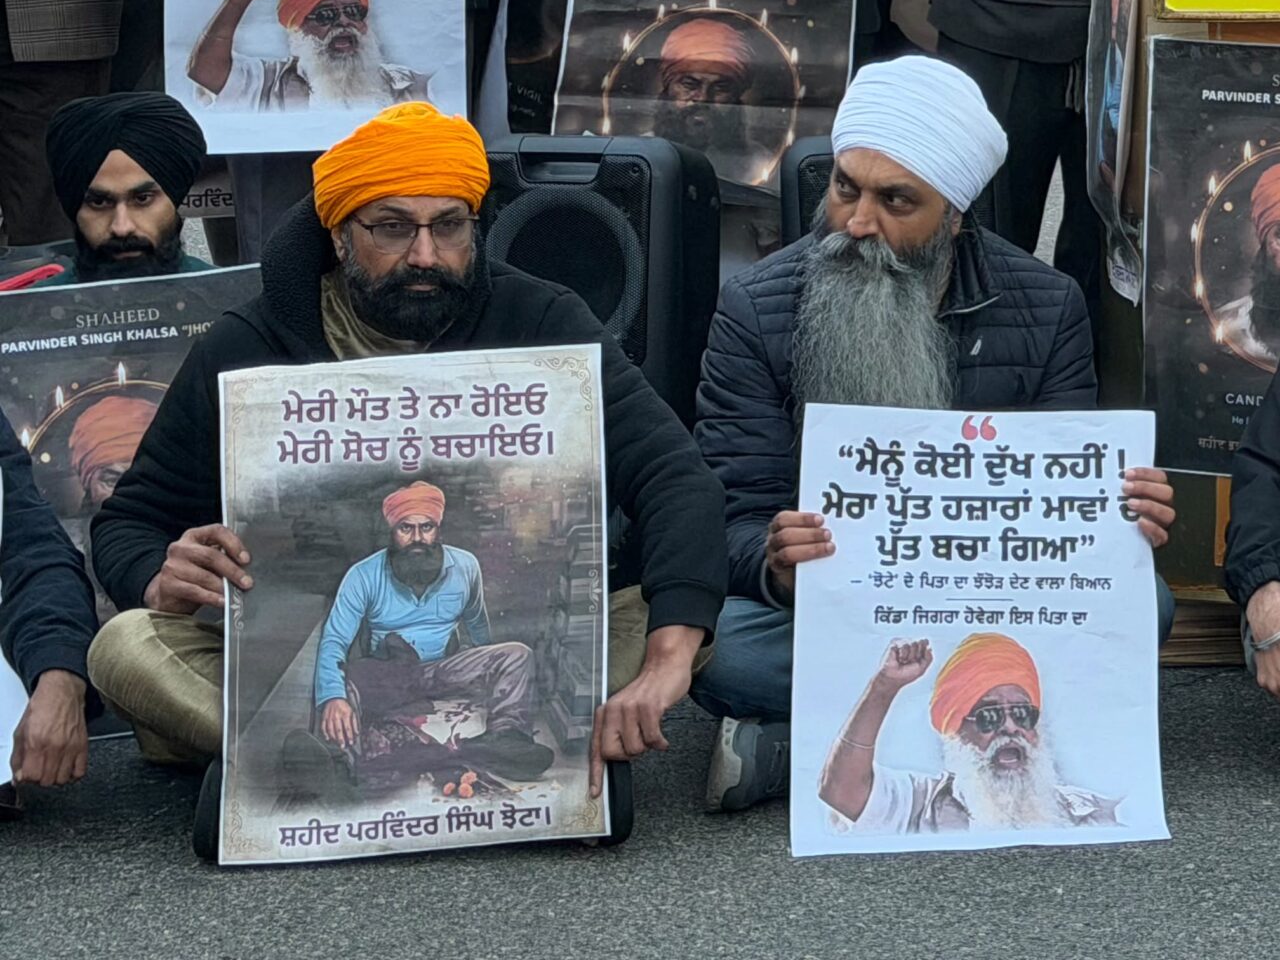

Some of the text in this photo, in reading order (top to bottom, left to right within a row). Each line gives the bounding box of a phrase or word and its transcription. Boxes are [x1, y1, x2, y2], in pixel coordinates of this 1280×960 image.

[1202, 90, 1271, 104] PARVINDER
[75, 308, 160, 329] SHAHEED
[1, 327, 179, 354] PARVINDER SINGH KHALSA
[282, 382, 548, 424] ਮੇਰੀ ਮੌਤ ਤੇ ਨਾ ਰੋਇਓ
[277, 429, 333, 464] ਮੇਰੀ
[341, 429, 390, 462] ਸੋਚ
[397, 426, 423, 471] ਨੂੰ
[913, 440, 975, 478] ਕੋਈ
[983, 444, 1035, 486] ਦੁੱਖ
[1043, 444, 1108, 480] ਨਹੀਂ
[822, 482, 1109, 526] ਮੇਰਾ ਪੁੱਤ ਹਜ਼ਾਰਾਂ ਮਾਵਾਂ
[876, 527, 922, 566] ਪੁੱਤ
[930, 535, 990, 562] ਬਚਾ
[278, 818, 341, 847] ਸ਼ਹੀਦ
[346, 810, 439, 842] ਪਰਵਿੰਦਰ
[447, 805, 494, 834] ਸਿੰਘ
